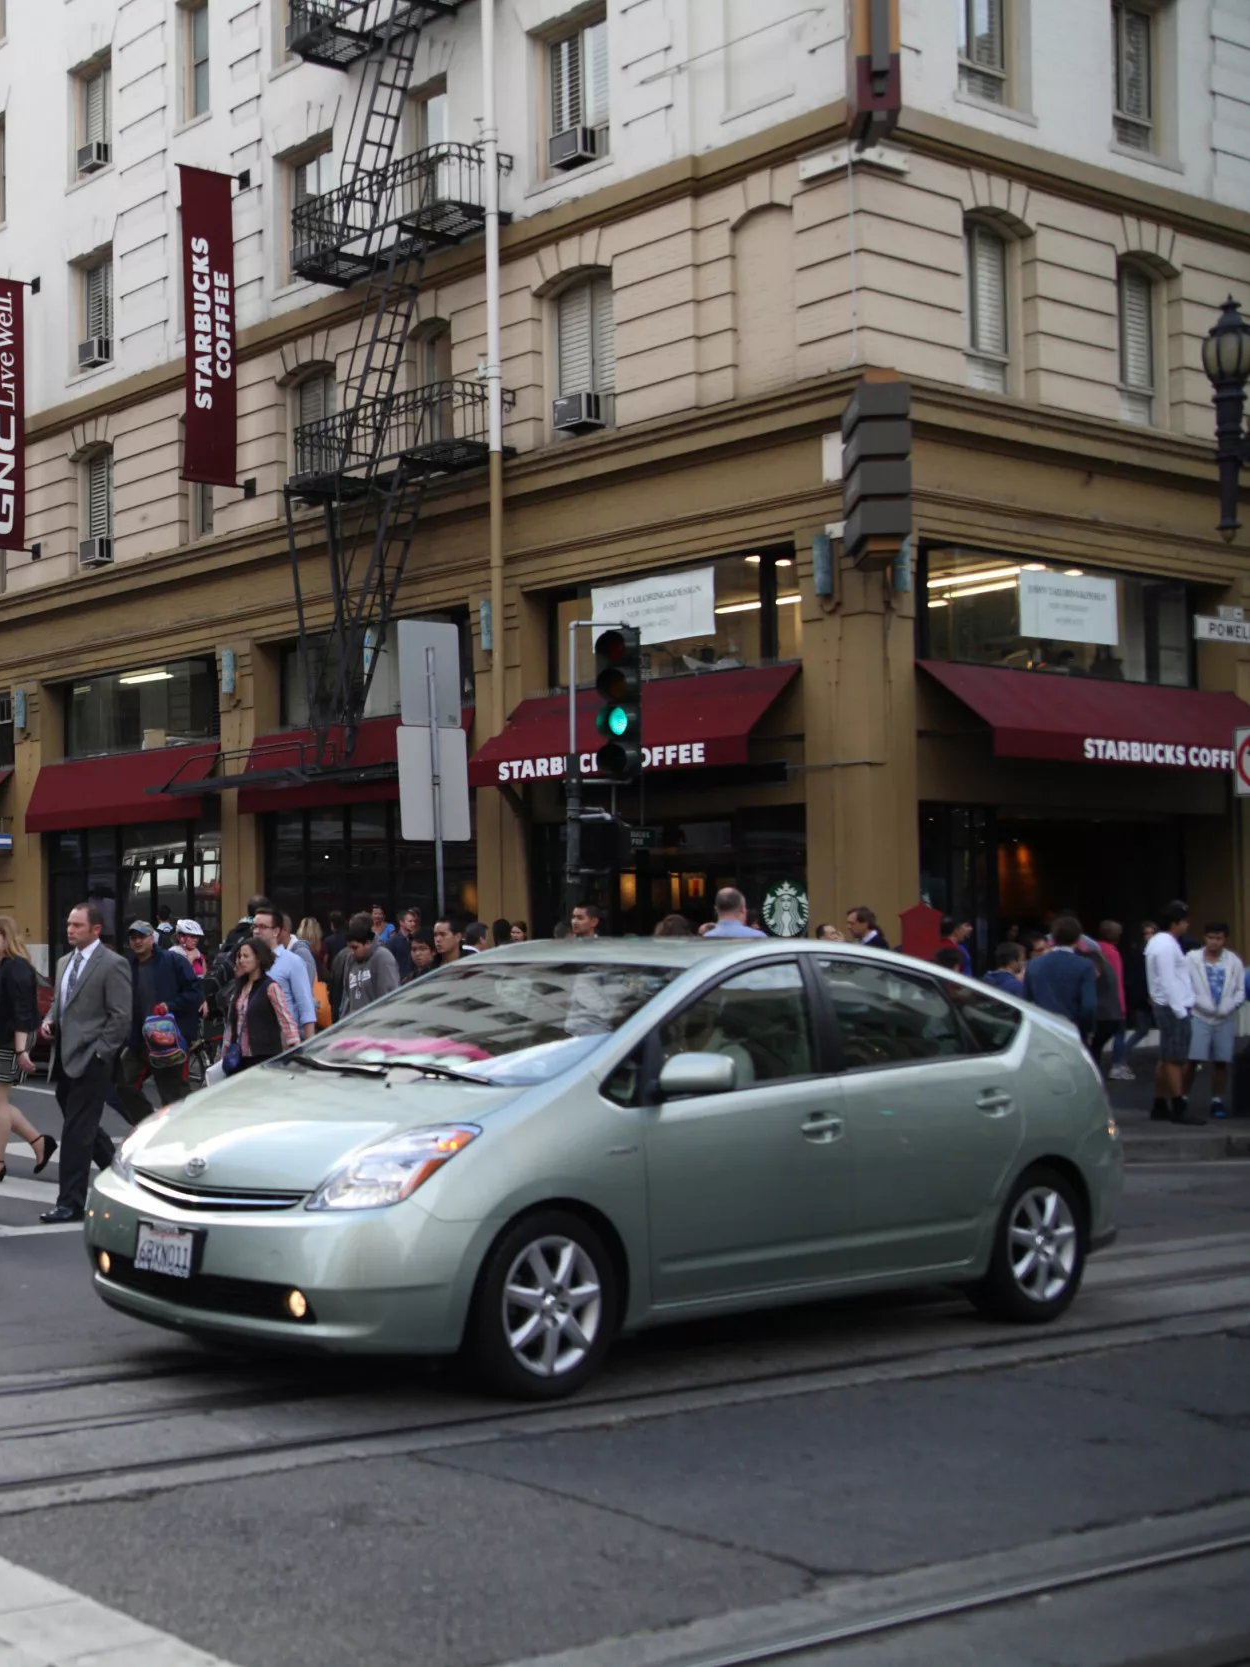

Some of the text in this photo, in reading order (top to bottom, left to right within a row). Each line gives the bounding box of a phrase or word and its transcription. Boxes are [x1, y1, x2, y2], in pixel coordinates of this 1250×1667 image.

[191, 236, 213, 410] STARBUCKS
[213, 270, 232, 379] COFFEE
[1209, 622, 1248, 639] POWEL
[498, 742, 705, 780] STARBC OFFEE
[1083, 738, 1235, 769] STARBUCKS COFF
